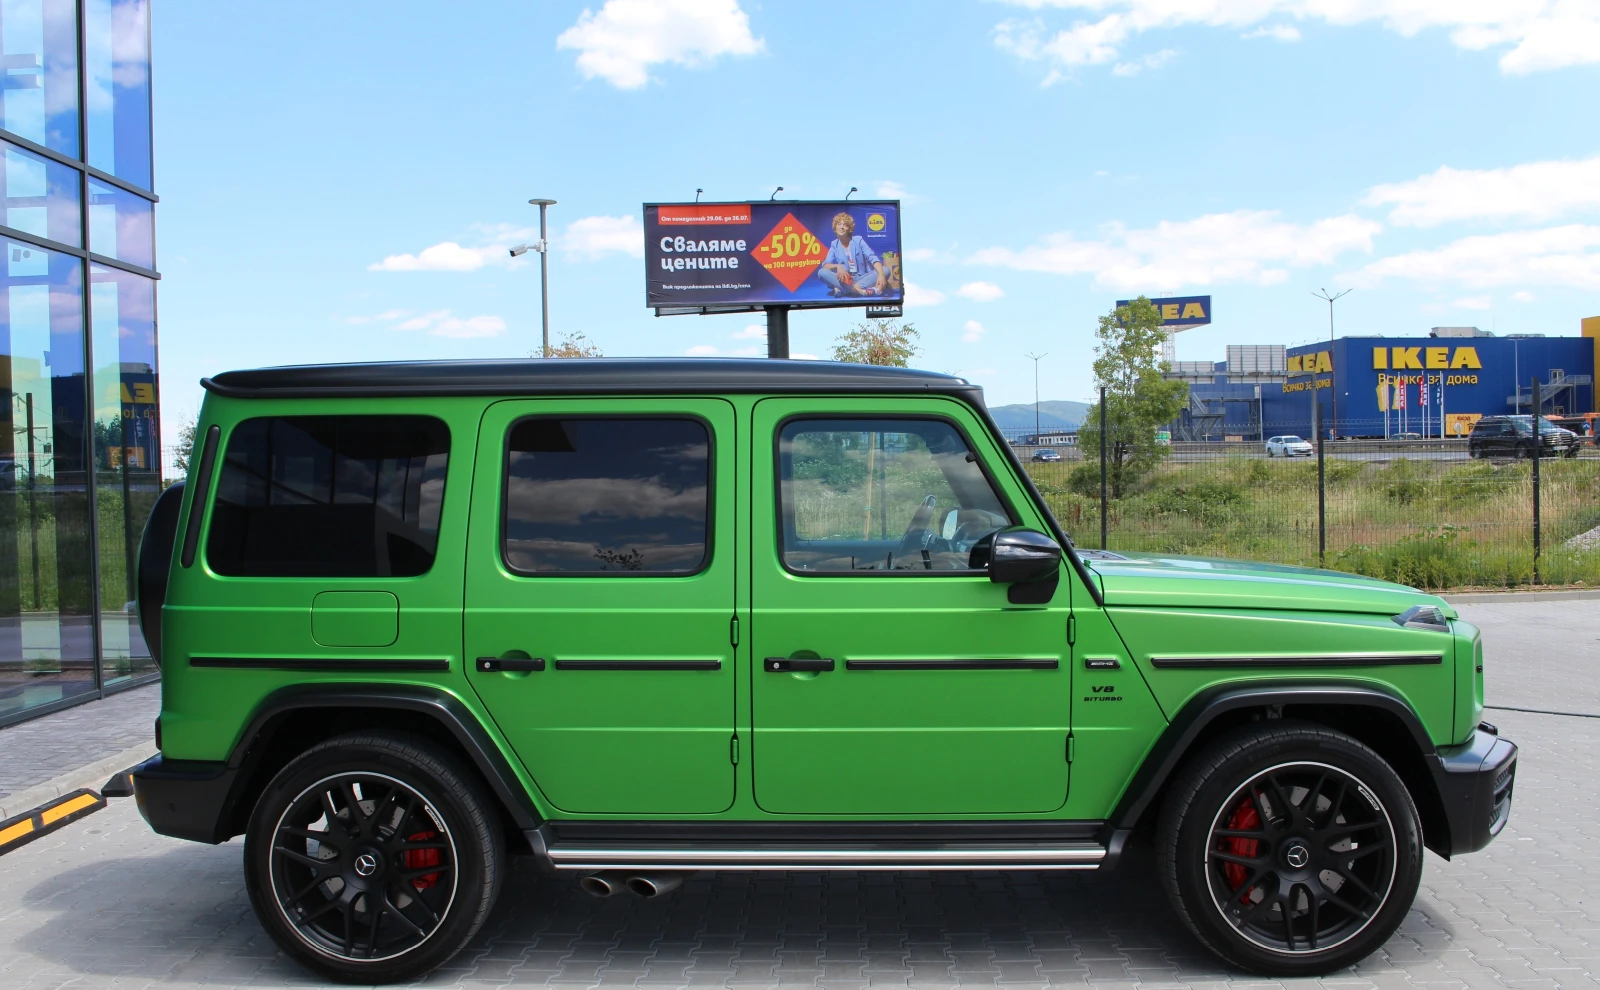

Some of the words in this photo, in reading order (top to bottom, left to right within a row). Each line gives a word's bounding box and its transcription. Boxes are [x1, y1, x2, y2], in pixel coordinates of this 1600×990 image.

[660, 236, 747, 252] Сваляме
[760, 232, 821, 258] -50%
[661, 257, 739, 272] цените
[787, 259, 821, 268] продукта
[1287, 350, 1333, 378] KEA
[1373, 347, 1483, 369] IKEA
[1446, 375, 1478, 386] дома
